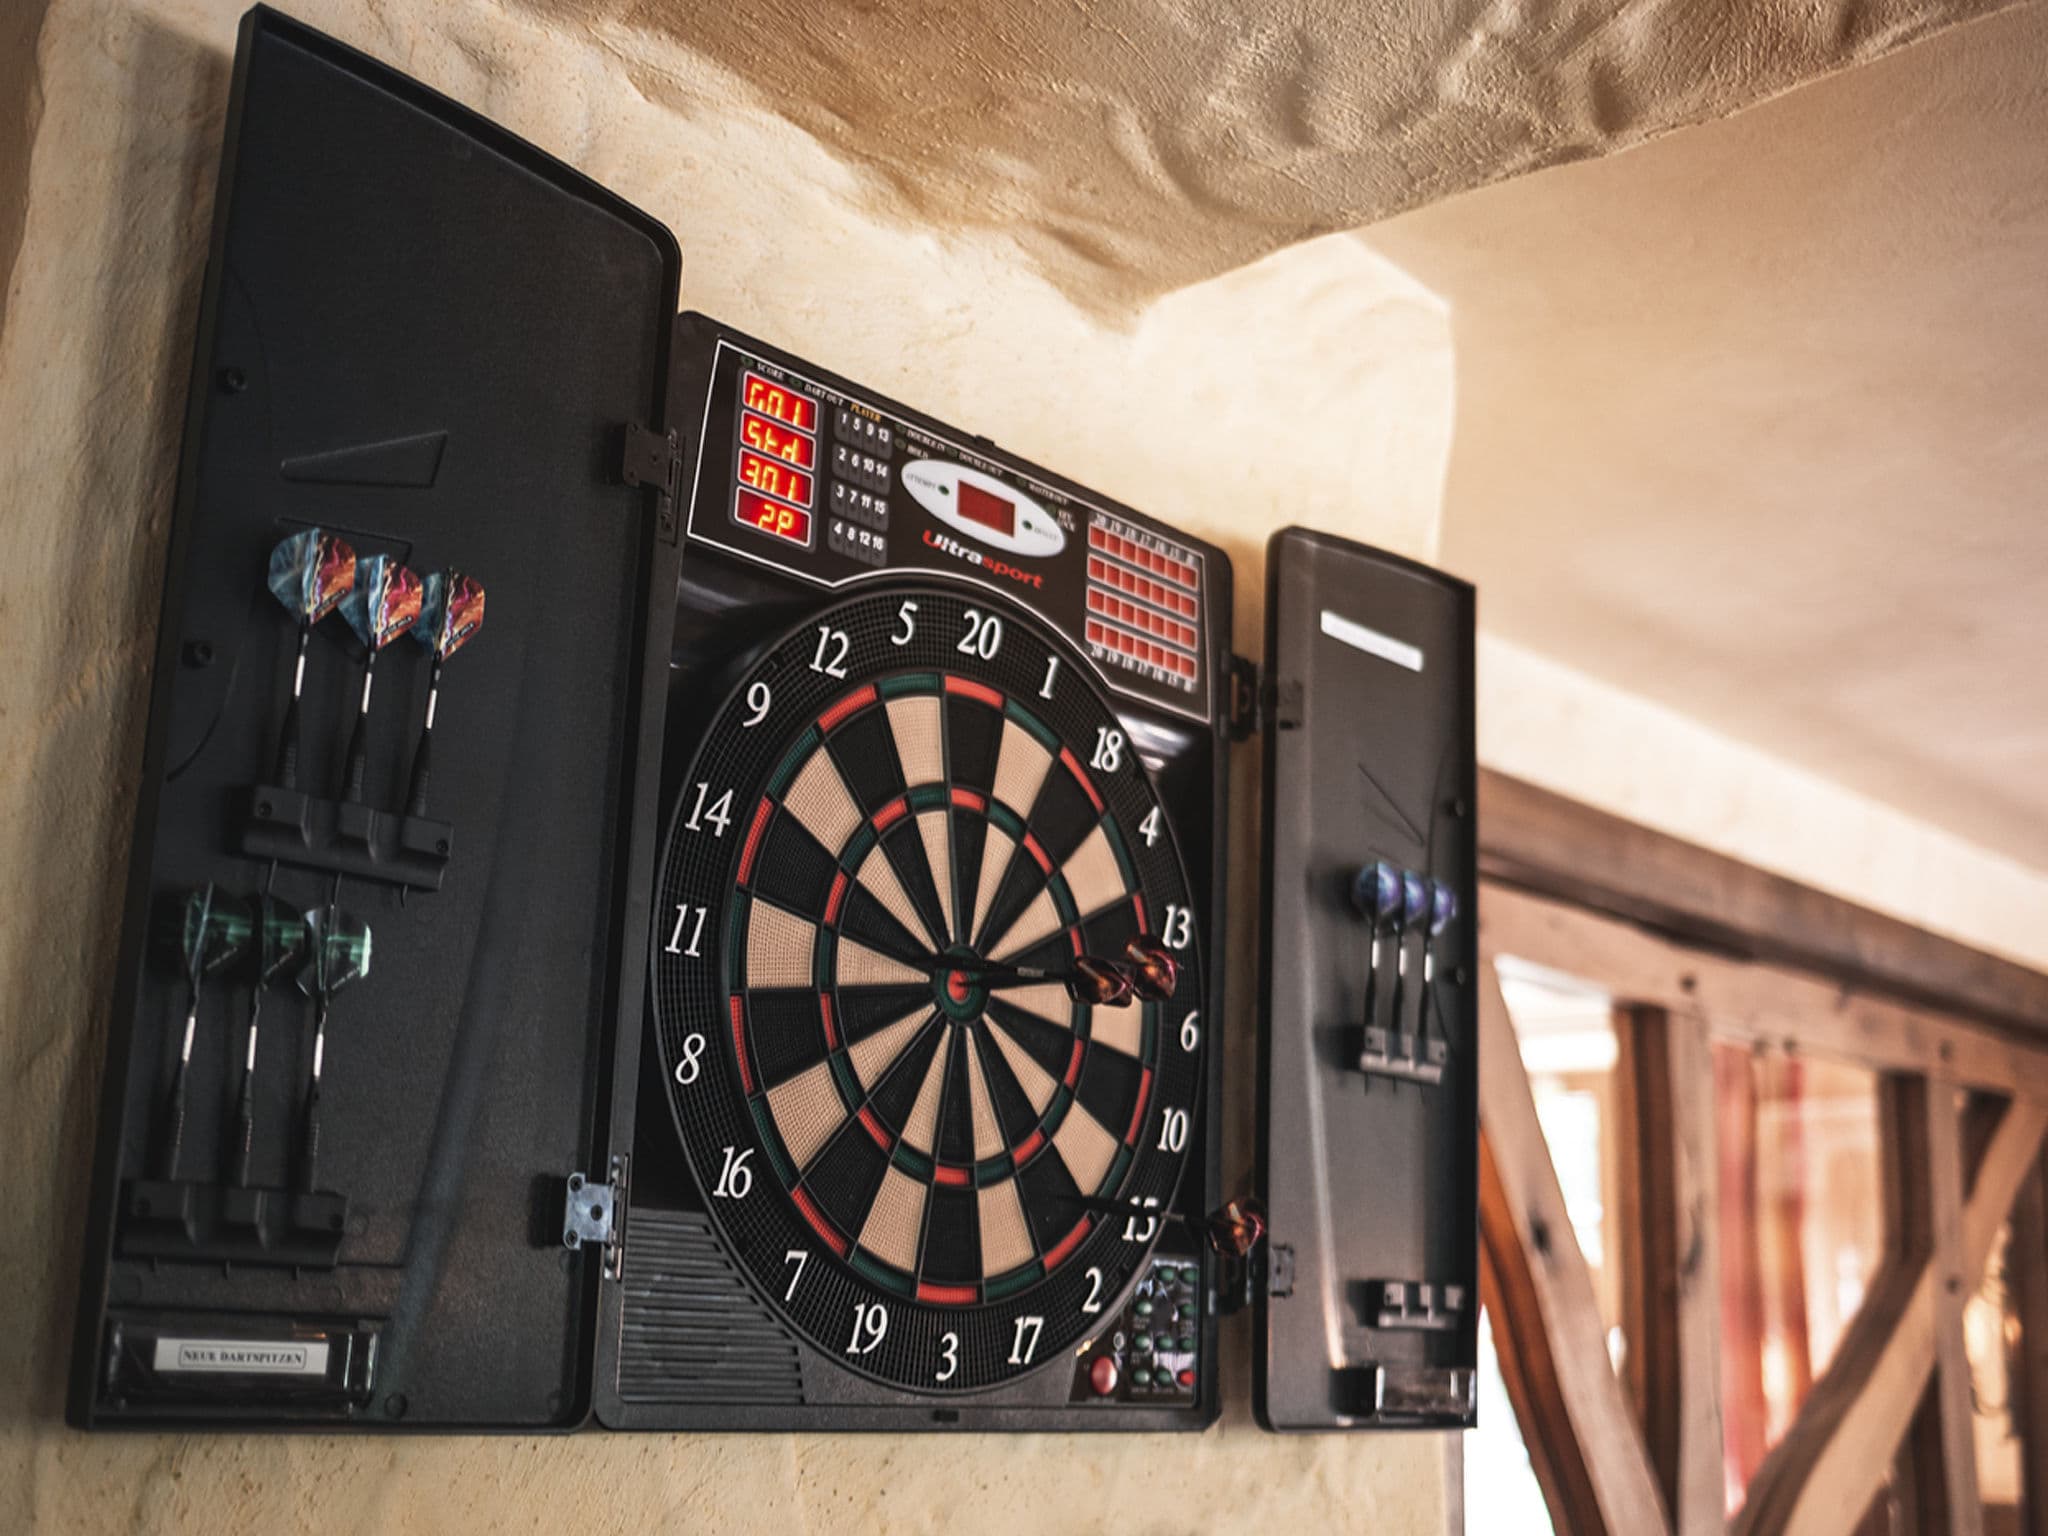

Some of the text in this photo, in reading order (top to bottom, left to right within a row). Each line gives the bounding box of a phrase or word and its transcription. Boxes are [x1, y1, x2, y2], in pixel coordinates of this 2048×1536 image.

[841, 412, 890, 443] 1 5 9 13
[838, 447, 846, 461] 2
[863, 458, 875, 473] 10
[876, 463, 888, 478] 14
[836, 484, 886, 515] 3 7 11 15
[834, 521, 842, 535] 4
[860, 530, 871, 546] 12
[873, 535, 884, 551] 16
[922, 529, 1043, 590] Ultrasport
[891, 600, 919, 646] 5
[956, 609, 1002, 660] 20
[809, 626, 850, 679] 12
[1038, 656, 1059, 700] 1
[742, 682, 771, 727] 9
[1089, 727, 1124, 773] 18
[685, 782, 734, 837] 14
[1138, 805, 1160, 847] 4
[665, 903, 707, 958] 11
[1162, 904, 1191, 950] 13
[1180, 1010, 1199, 1052] 6
[675, 1033, 706, 1085] 8
[1157, 1107, 1188, 1153] 10
[712, 1146, 754, 1199] 16
[784, 1250, 808, 1302] 7
[1082, 1266, 1102, 1313] 2
[846, 1303, 888, 1354] 19
[1007, 1316, 1044, 1365] 17
[184, 1350, 302, 1365] NEUE DARTSPITZEN
[935, 1331, 959, 1381] 3
